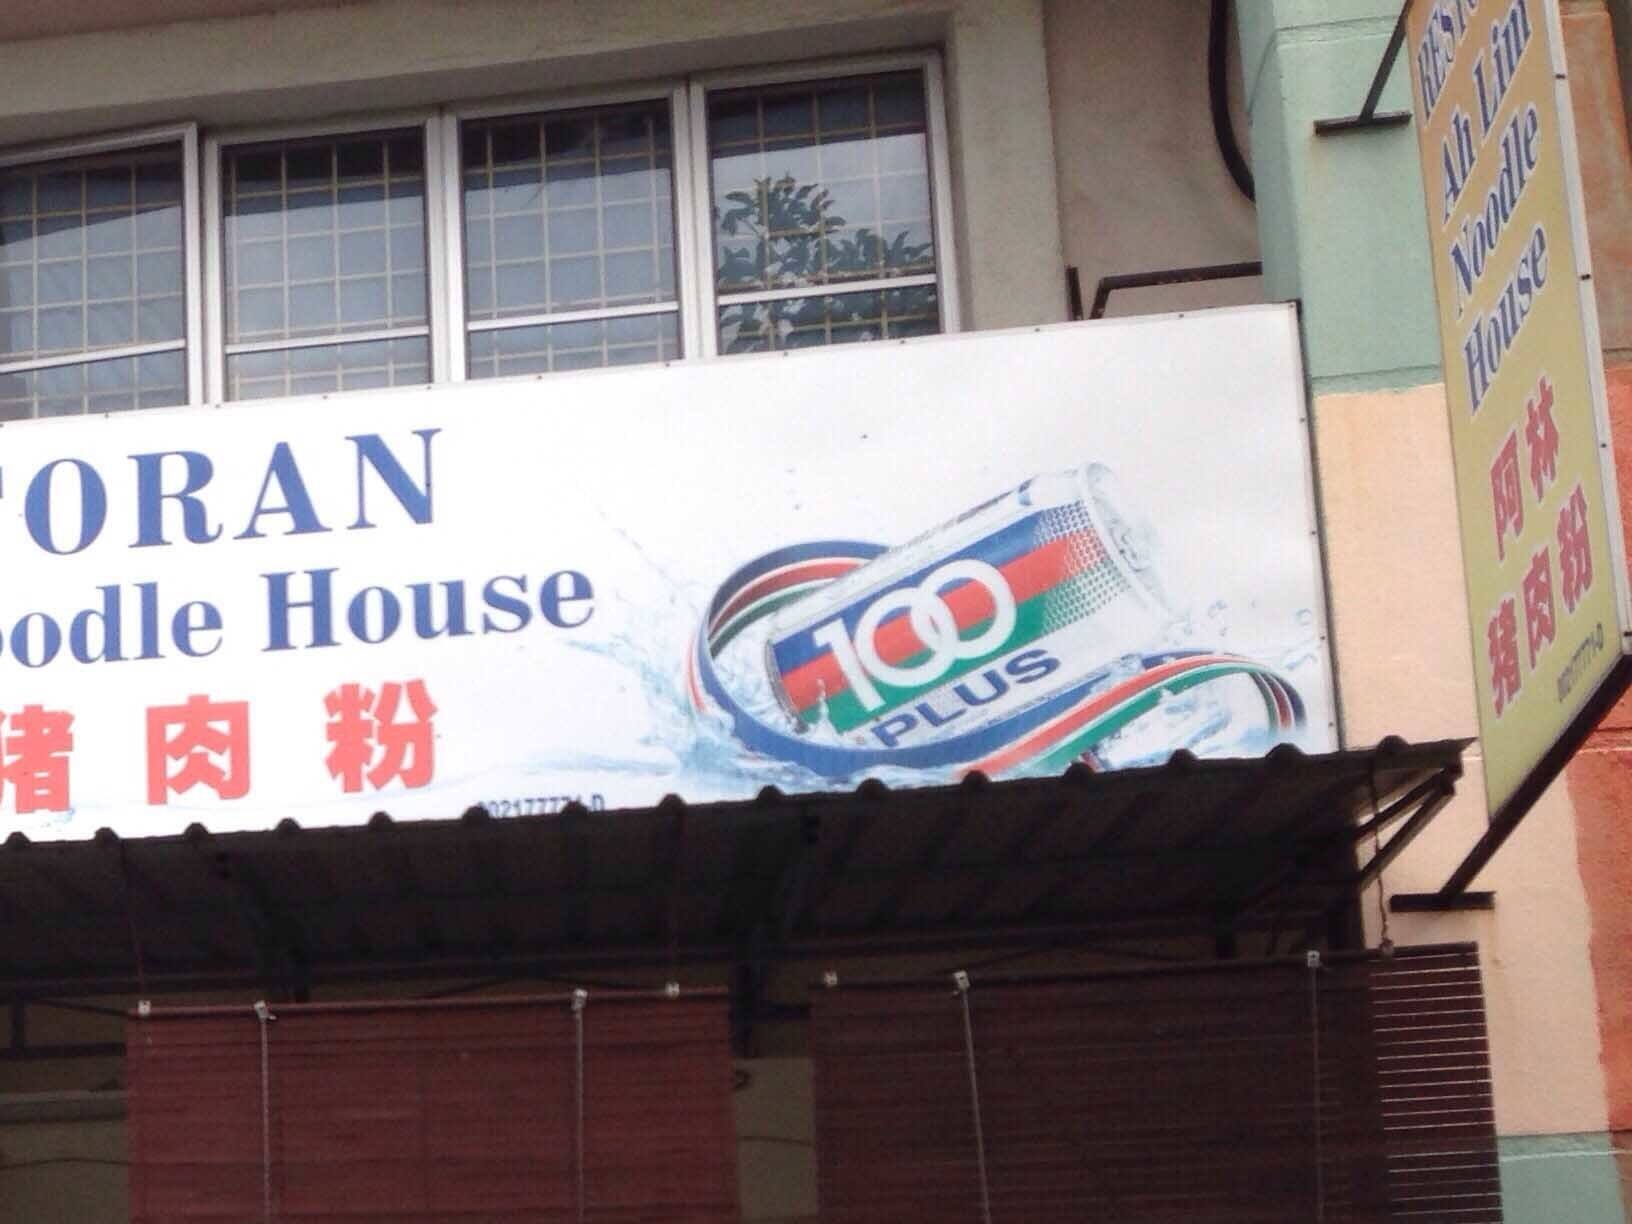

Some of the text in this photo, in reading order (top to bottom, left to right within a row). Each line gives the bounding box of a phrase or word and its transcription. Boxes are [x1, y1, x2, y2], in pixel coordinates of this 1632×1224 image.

[1443, 0, 1532, 224] Ah Lim
[1451, 108, 1538, 317] Noodle
[1464, 226, 1547, 416] House
[1490, 376, 1559, 561] 阿林
[261, 567, 597, 652] House
[814, 558, 1017, 712] 100
[1487, 485, 1593, 719] 猪肉粉
[872, 648, 1060, 748] PLUS
